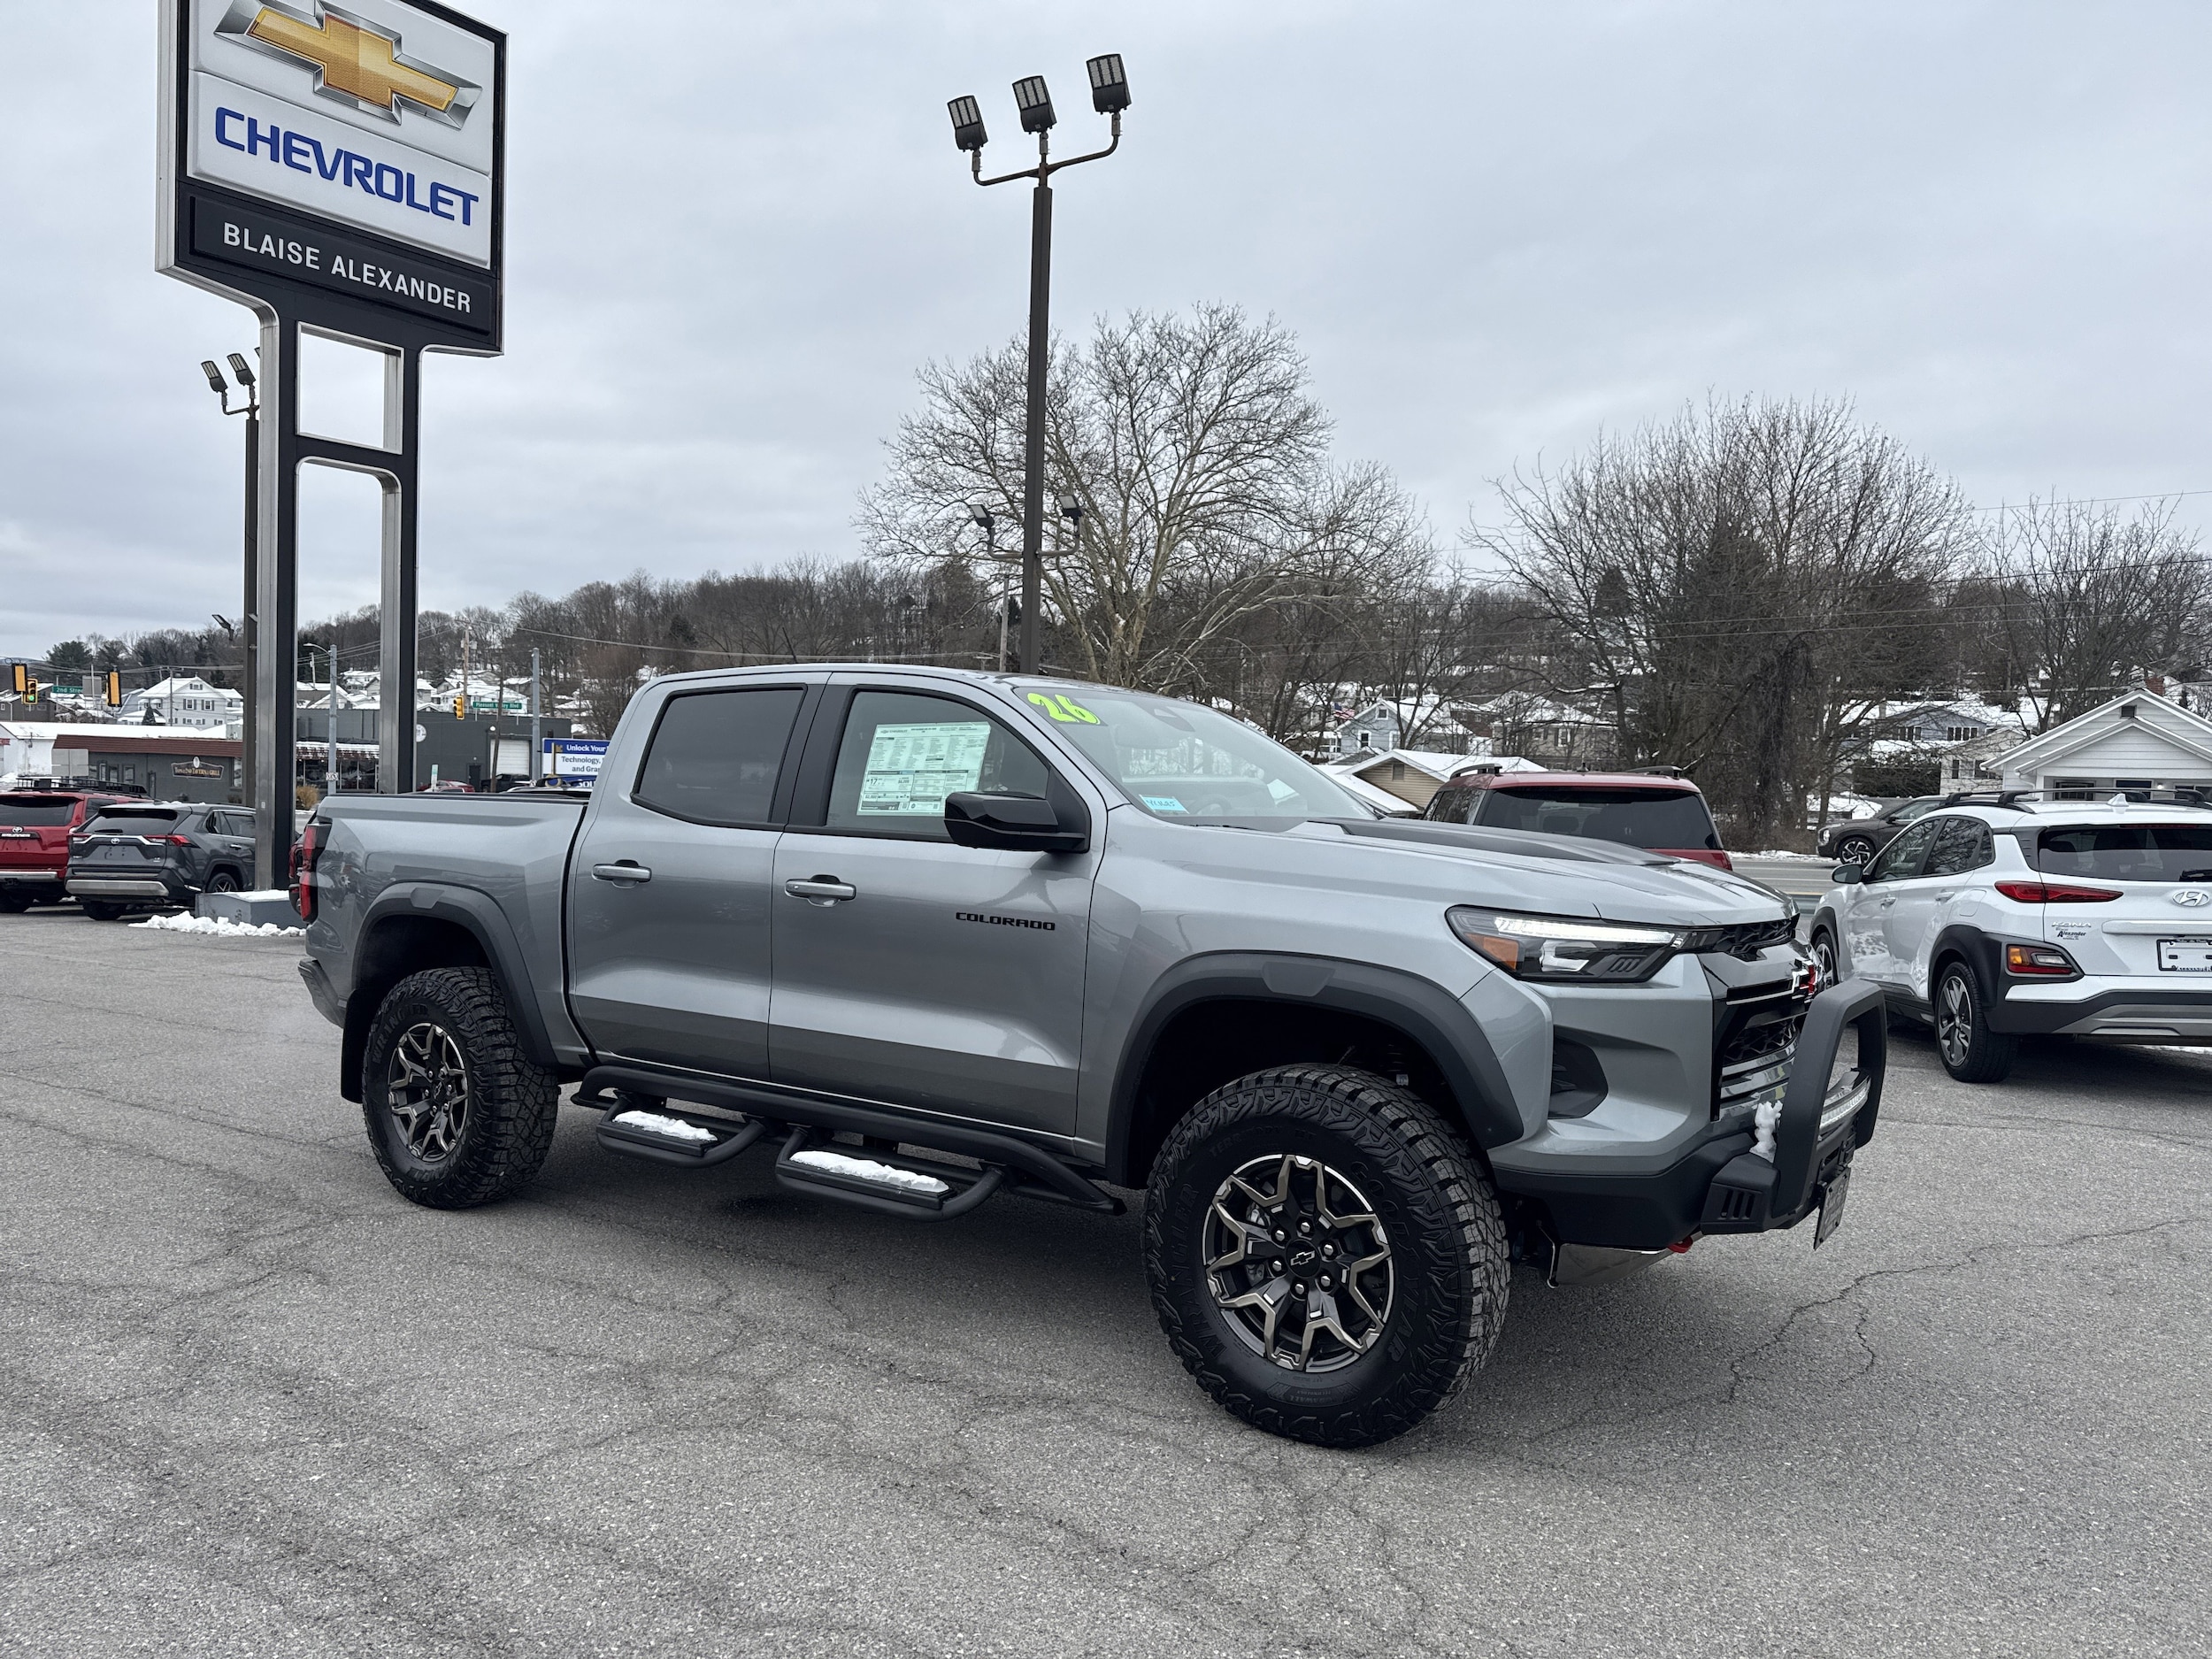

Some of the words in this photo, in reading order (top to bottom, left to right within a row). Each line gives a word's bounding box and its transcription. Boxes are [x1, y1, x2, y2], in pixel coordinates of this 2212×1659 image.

[215, 106, 479, 226] CHEVROLET
[223, 221, 320, 271] BLAISE
[331, 255, 471, 313] ALEXANDER
[1027, 693, 1101, 725] 26
[561, 756, 601, 764] Technology,
[956, 911, 1056, 931] COLORADO
[1171, 1182, 1228, 1361] WRANGLER
[1351, 1161, 1422, 1363] GOODYEAR
